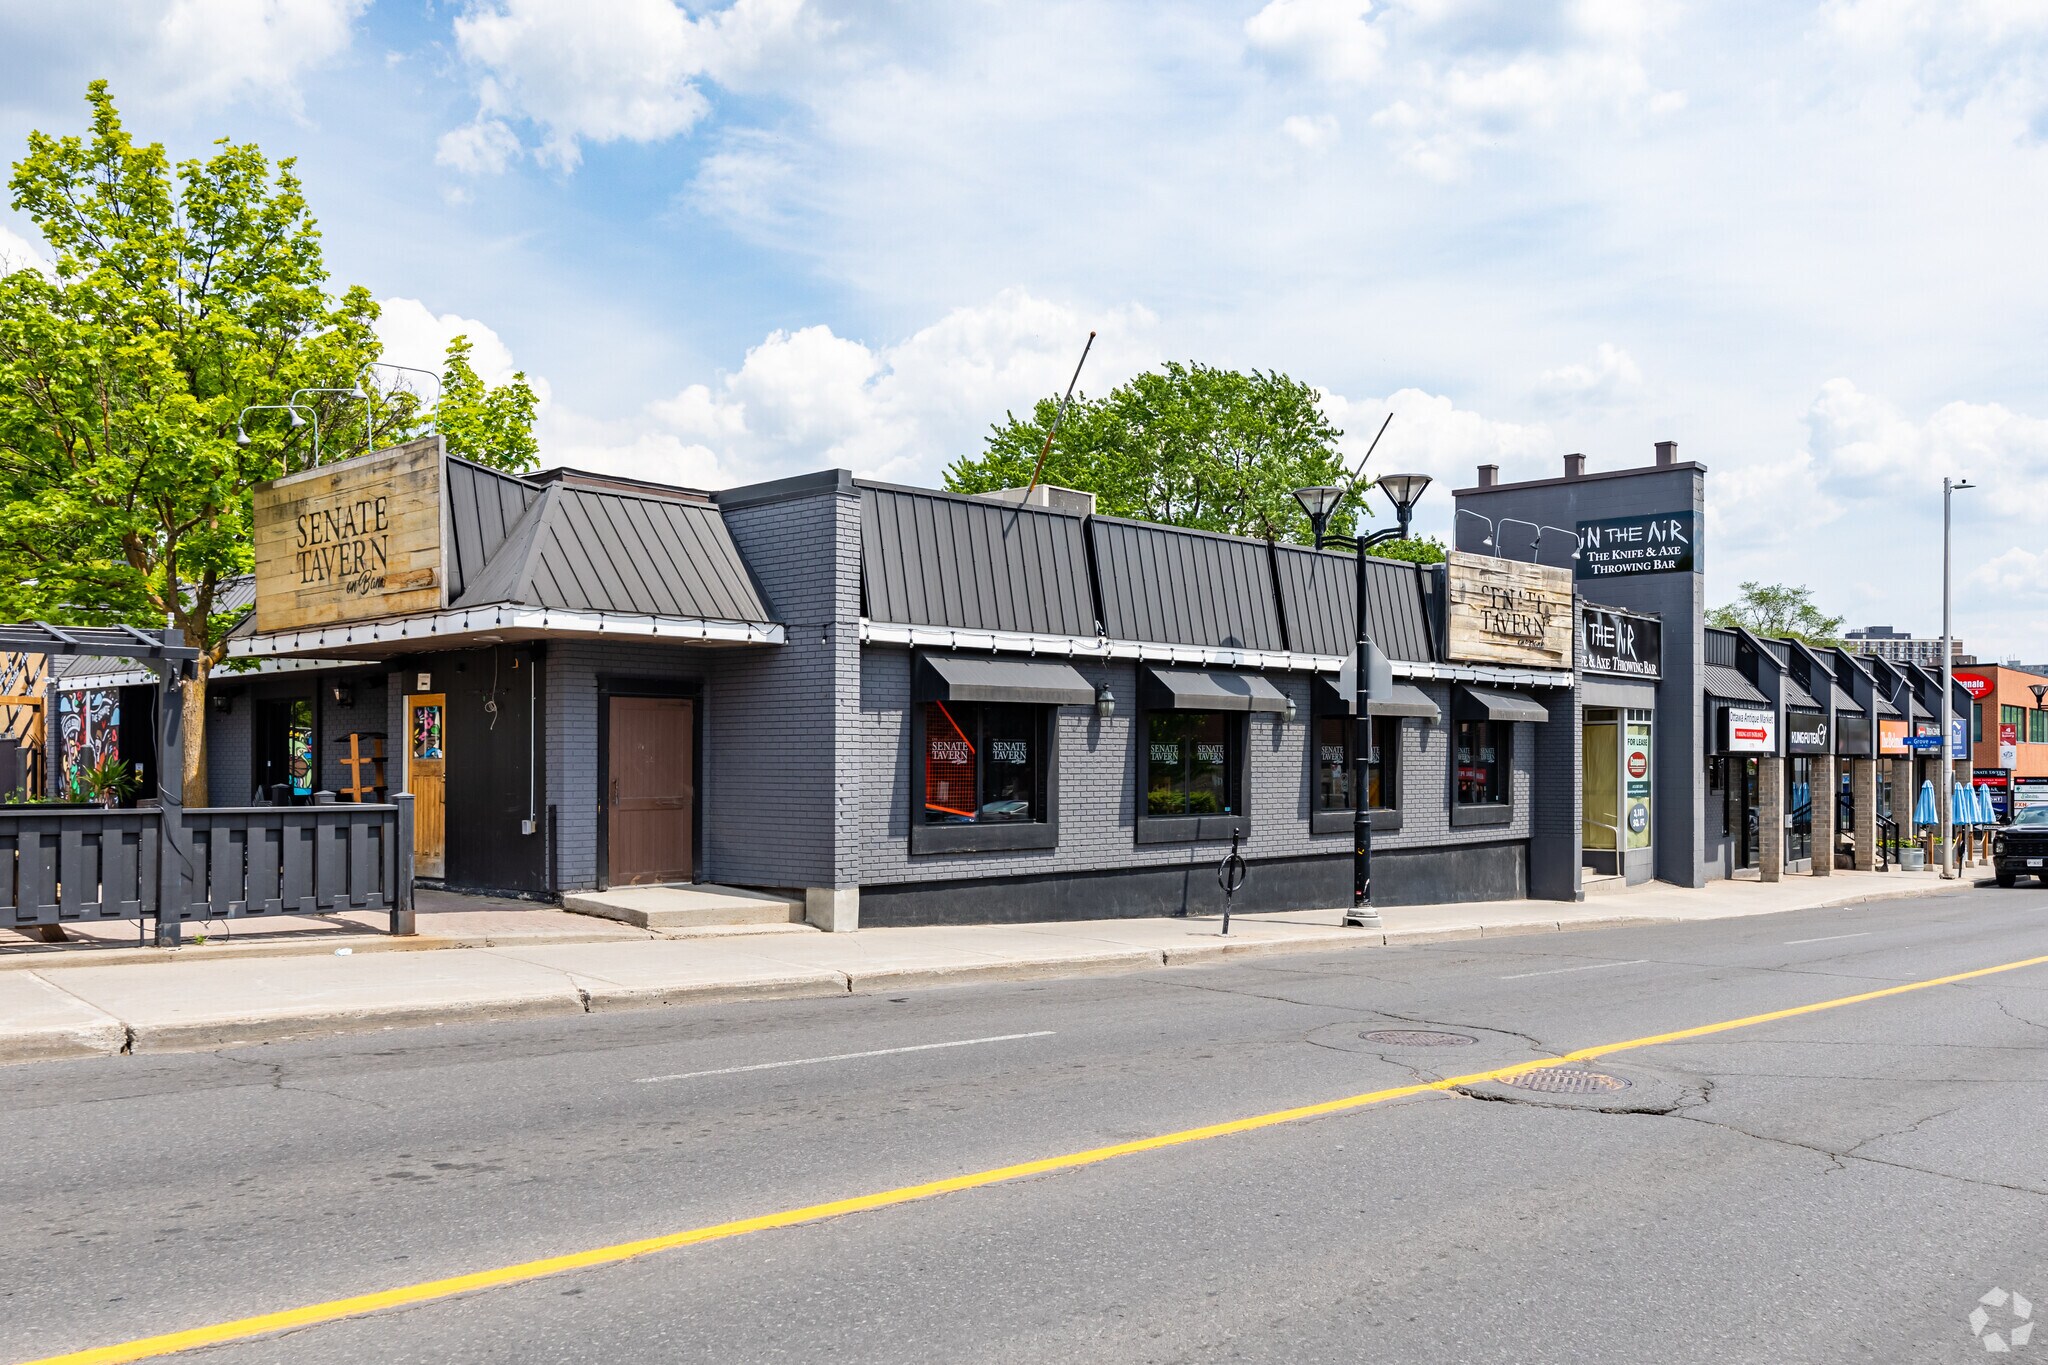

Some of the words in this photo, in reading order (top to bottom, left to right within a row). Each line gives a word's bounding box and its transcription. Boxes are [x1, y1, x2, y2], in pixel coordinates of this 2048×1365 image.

[297, 496, 388, 548] SENATE
[1604, 526, 1643, 543] THE
[297, 535, 389, 583] TAVERN
[1612, 549, 1644, 560] KNIFE
[1646, 547, 1657, 557] &
[1658, 545, 1681, 556] AXE
[1592, 562, 1651, 575] THROWING
[1653, 559, 1676, 570] BAR
[1481, 609, 1547, 639] TAVERN
[1589, 623, 1615, 648] THE
[1589, 654, 1596, 668] &
[1730, 711, 1743, 722] Ottawa
[1744, 712, 1759, 725] Antique
[1760, 713, 1773, 724] Market
[932, 742, 968, 751] SENATE
[993, 742, 1027, 751] SENATE
[1627, 738, 1635, 746] FOR
[1636, 738, 1648, 746] LEASE
[932, 751, 968, 760] TAVERN
[993, 751, 1026, 760] TAVERN
